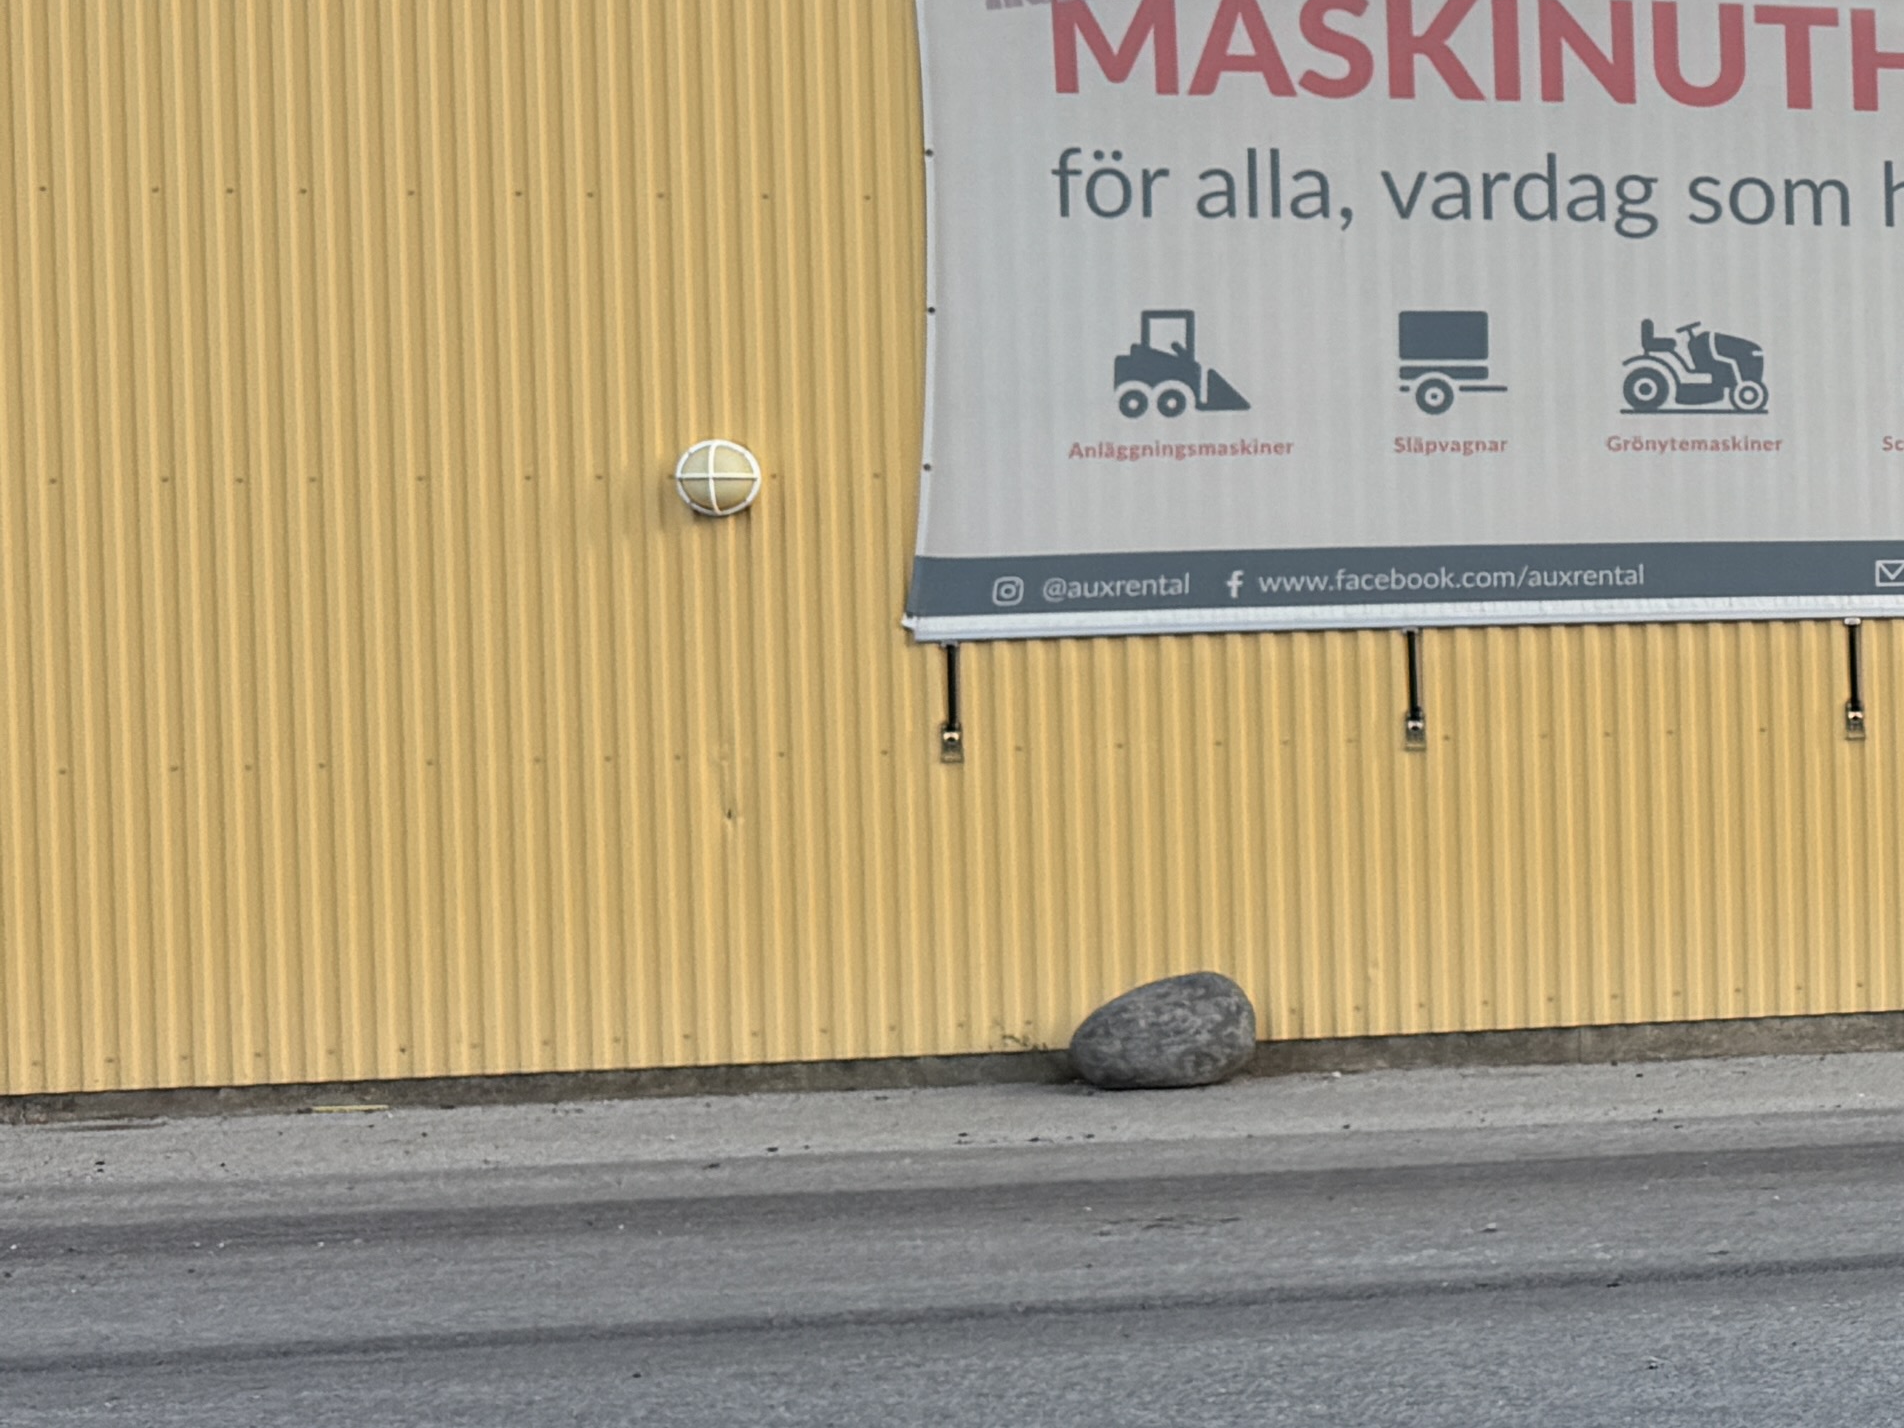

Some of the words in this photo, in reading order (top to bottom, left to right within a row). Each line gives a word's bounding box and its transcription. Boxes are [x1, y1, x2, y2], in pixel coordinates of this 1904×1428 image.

[1052, 148, 1170, 220] för
[1196, 147, 1355, 232] alla,
[1381, 152, 1660, 239] vardag
[1687, 174, 1852, 228] som
[1067, 438, 1295, 462] Anläggningsmaskiner
[1393, 434, 1508, 457] Släpvagnar
[1605, 433, 1783, 455] Grönytemaskiner
[1041, 572, 1191, 605] @auxrental
[1258, 564, 1646, 595] www.facebook.com/auxrental
